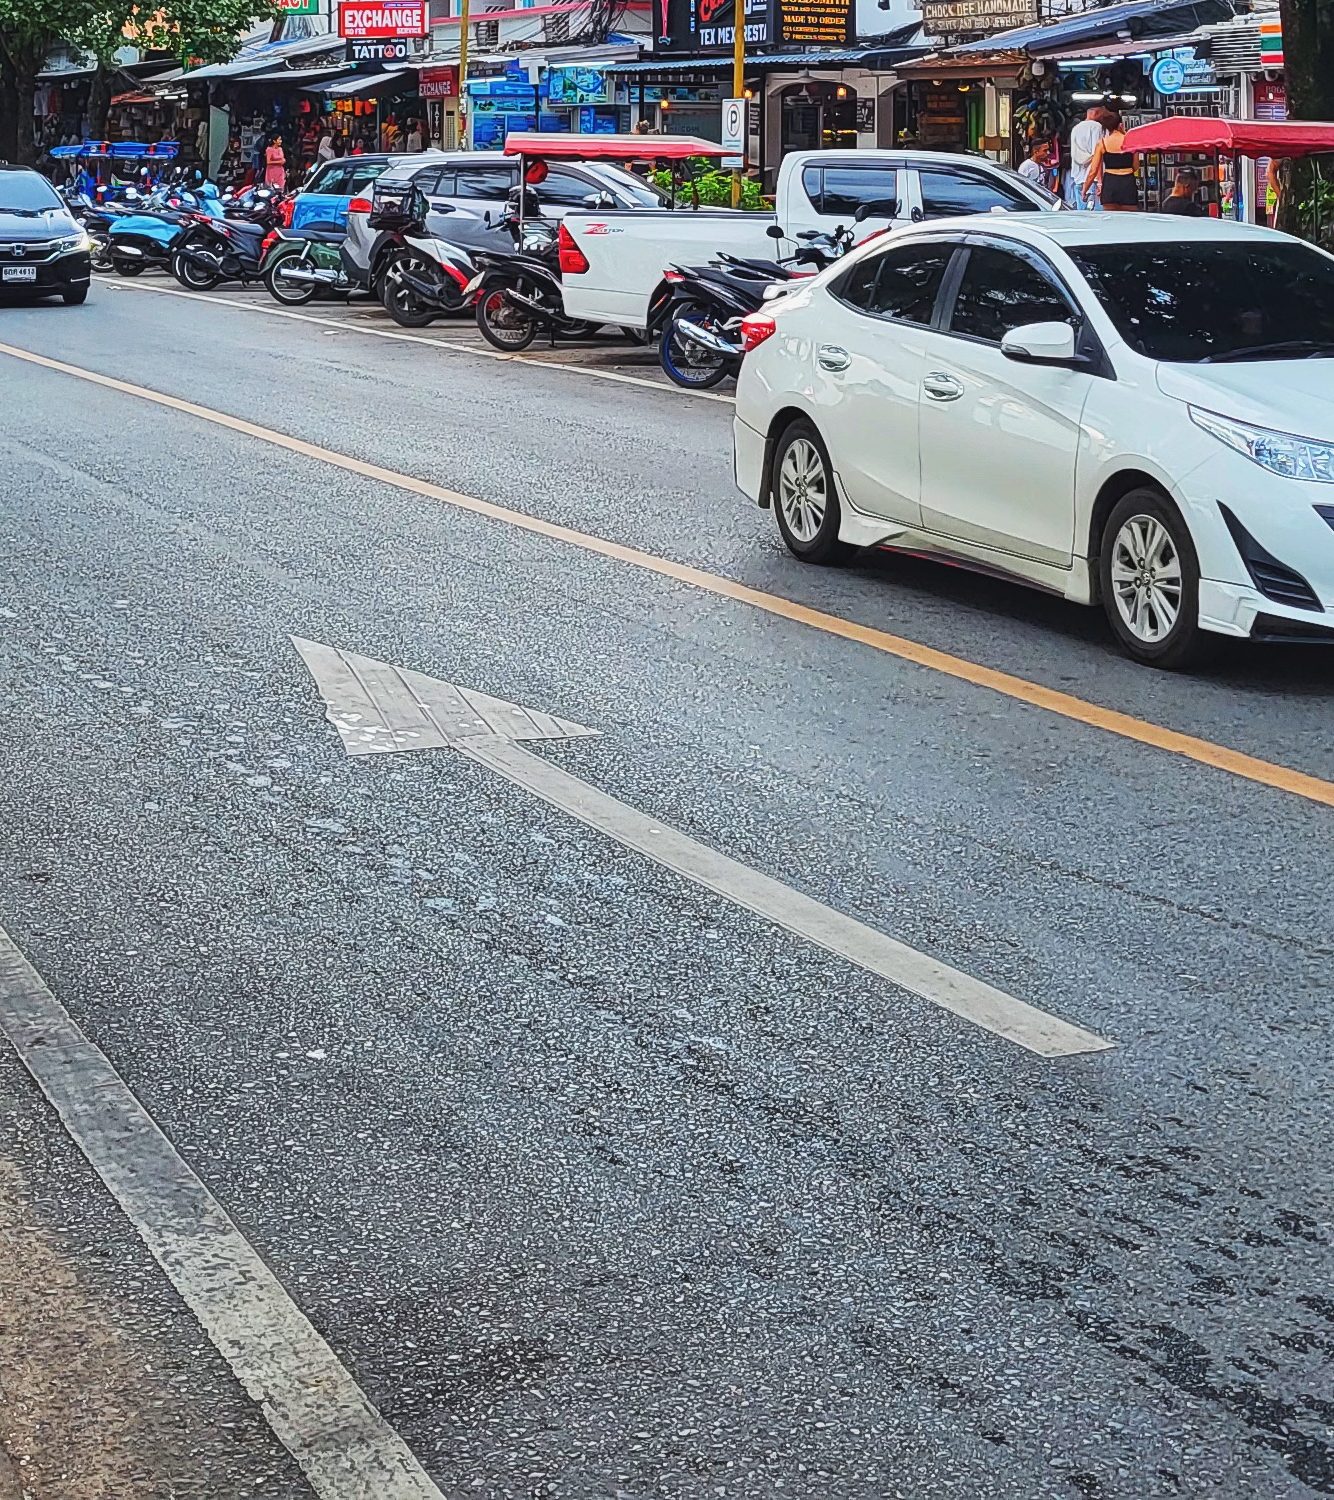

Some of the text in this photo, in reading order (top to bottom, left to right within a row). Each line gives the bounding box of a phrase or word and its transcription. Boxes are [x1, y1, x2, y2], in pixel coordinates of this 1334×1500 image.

[957, 2, 975, 16] DEE
[344, 9, 422, 28] EXCHANGE
[783, 15, 846, 25] MADE TO ORDER
[699, 28, 716, 46] TEX
[352, 44, 406, 59] TATTOO
